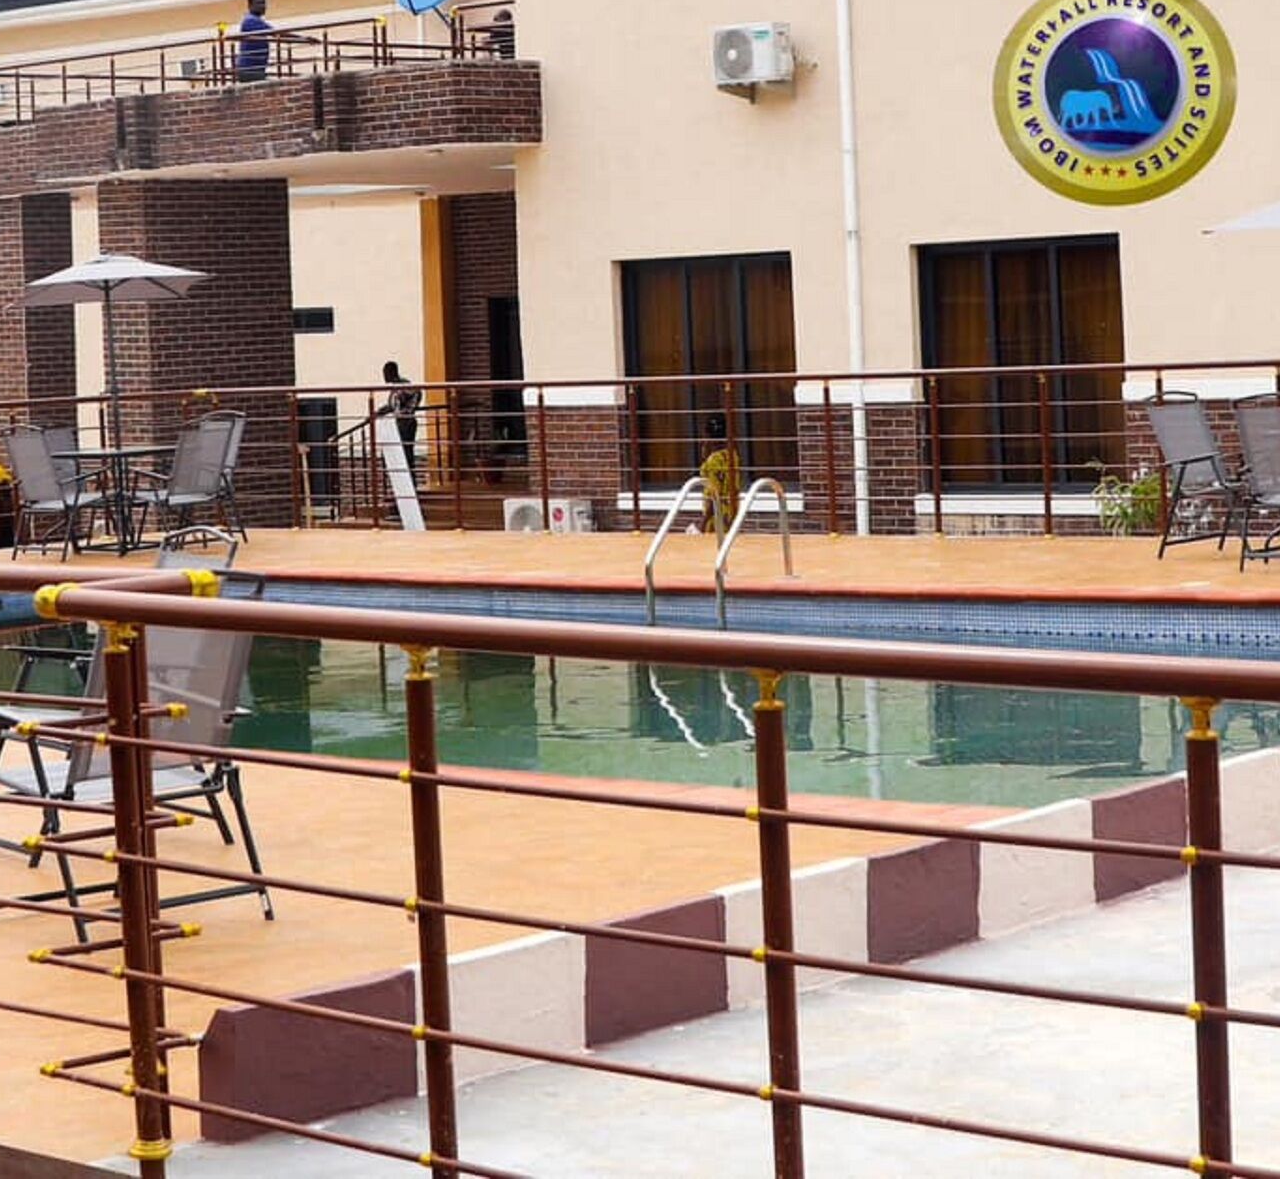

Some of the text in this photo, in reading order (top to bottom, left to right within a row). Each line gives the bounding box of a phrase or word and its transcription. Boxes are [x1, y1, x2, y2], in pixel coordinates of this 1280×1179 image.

[1187, 46, 1211, 98] AND
[1024, 117, 1080, 173] IBOM
[1134, 105, 1207, 178] SUITES
